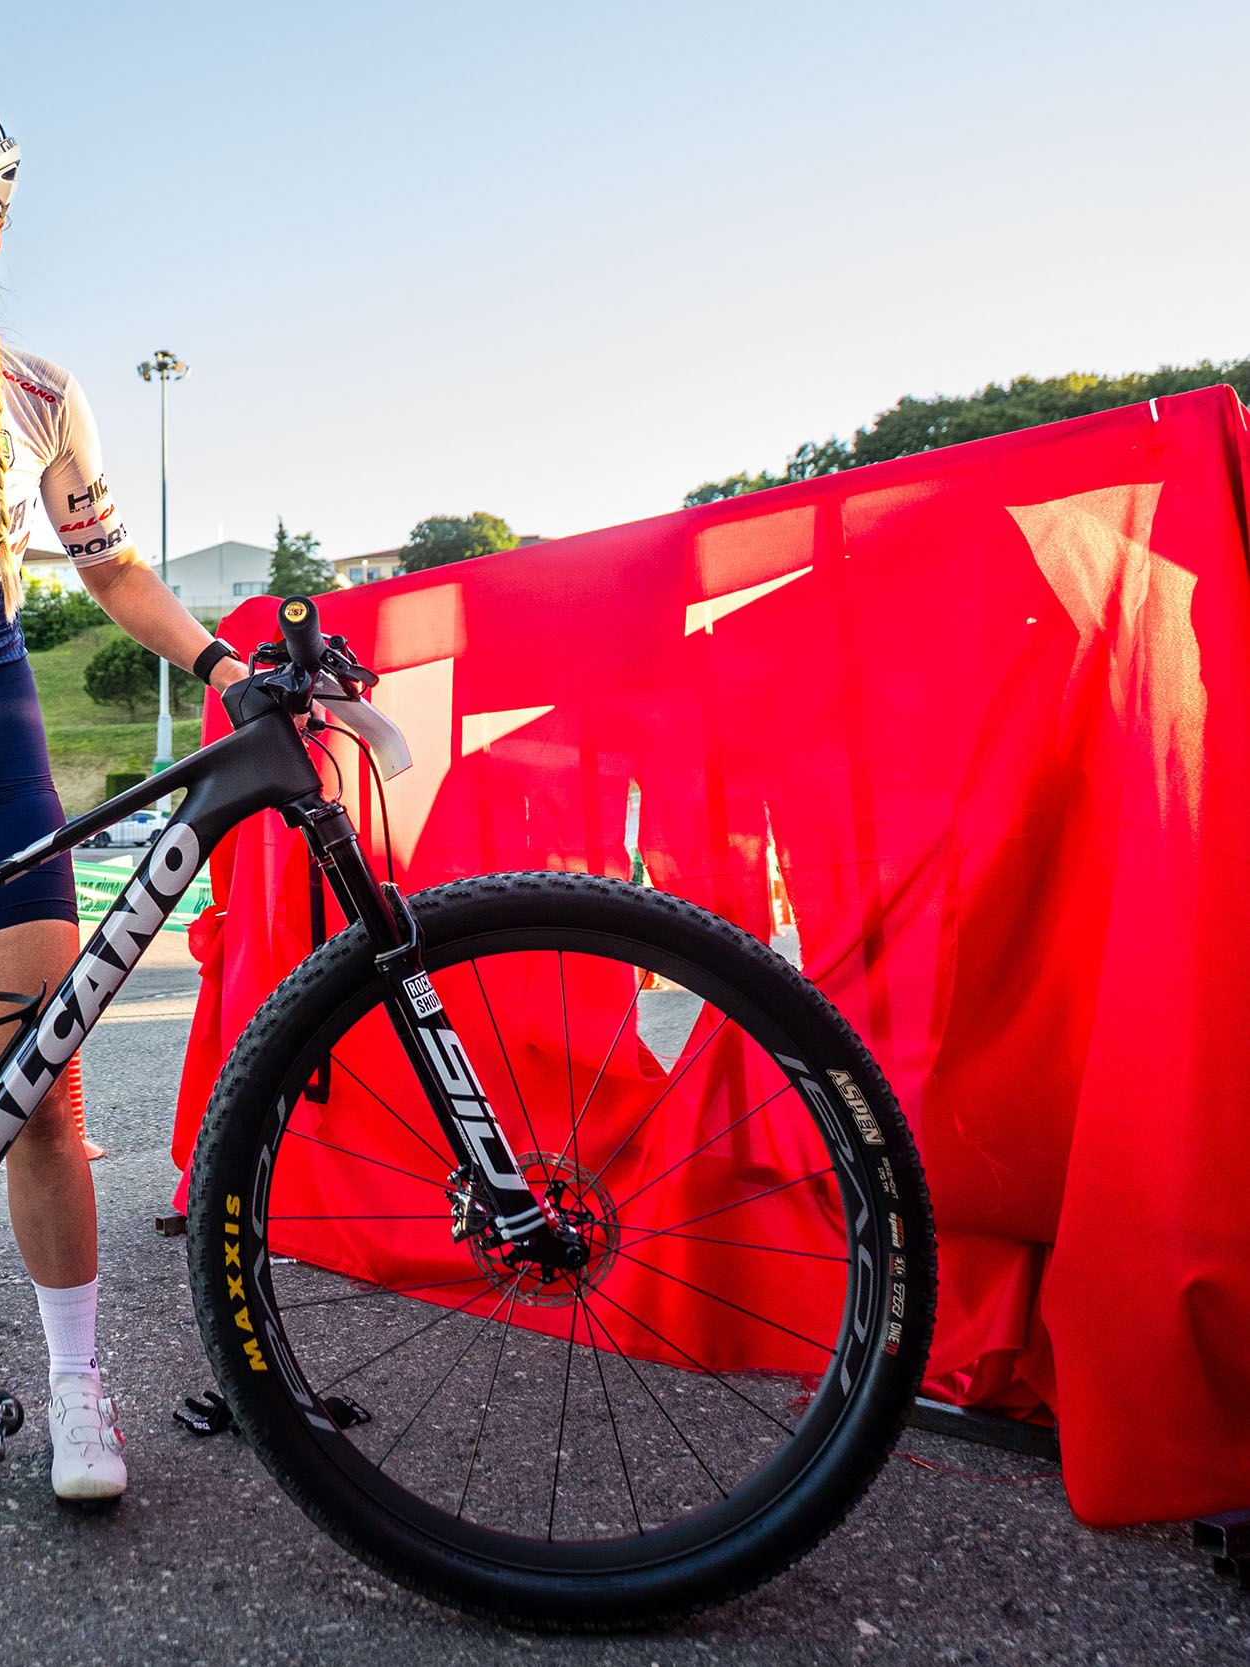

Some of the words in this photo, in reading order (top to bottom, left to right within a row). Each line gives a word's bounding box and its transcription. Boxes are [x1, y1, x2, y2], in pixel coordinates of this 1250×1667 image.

[2, 370, 56, 403] SALCANO
[826, 1068, 885, 1146] ASPEN
[225, 1194, 268, 1371] MAXXIS
[885, 1321, 903, 1357] ONE70
